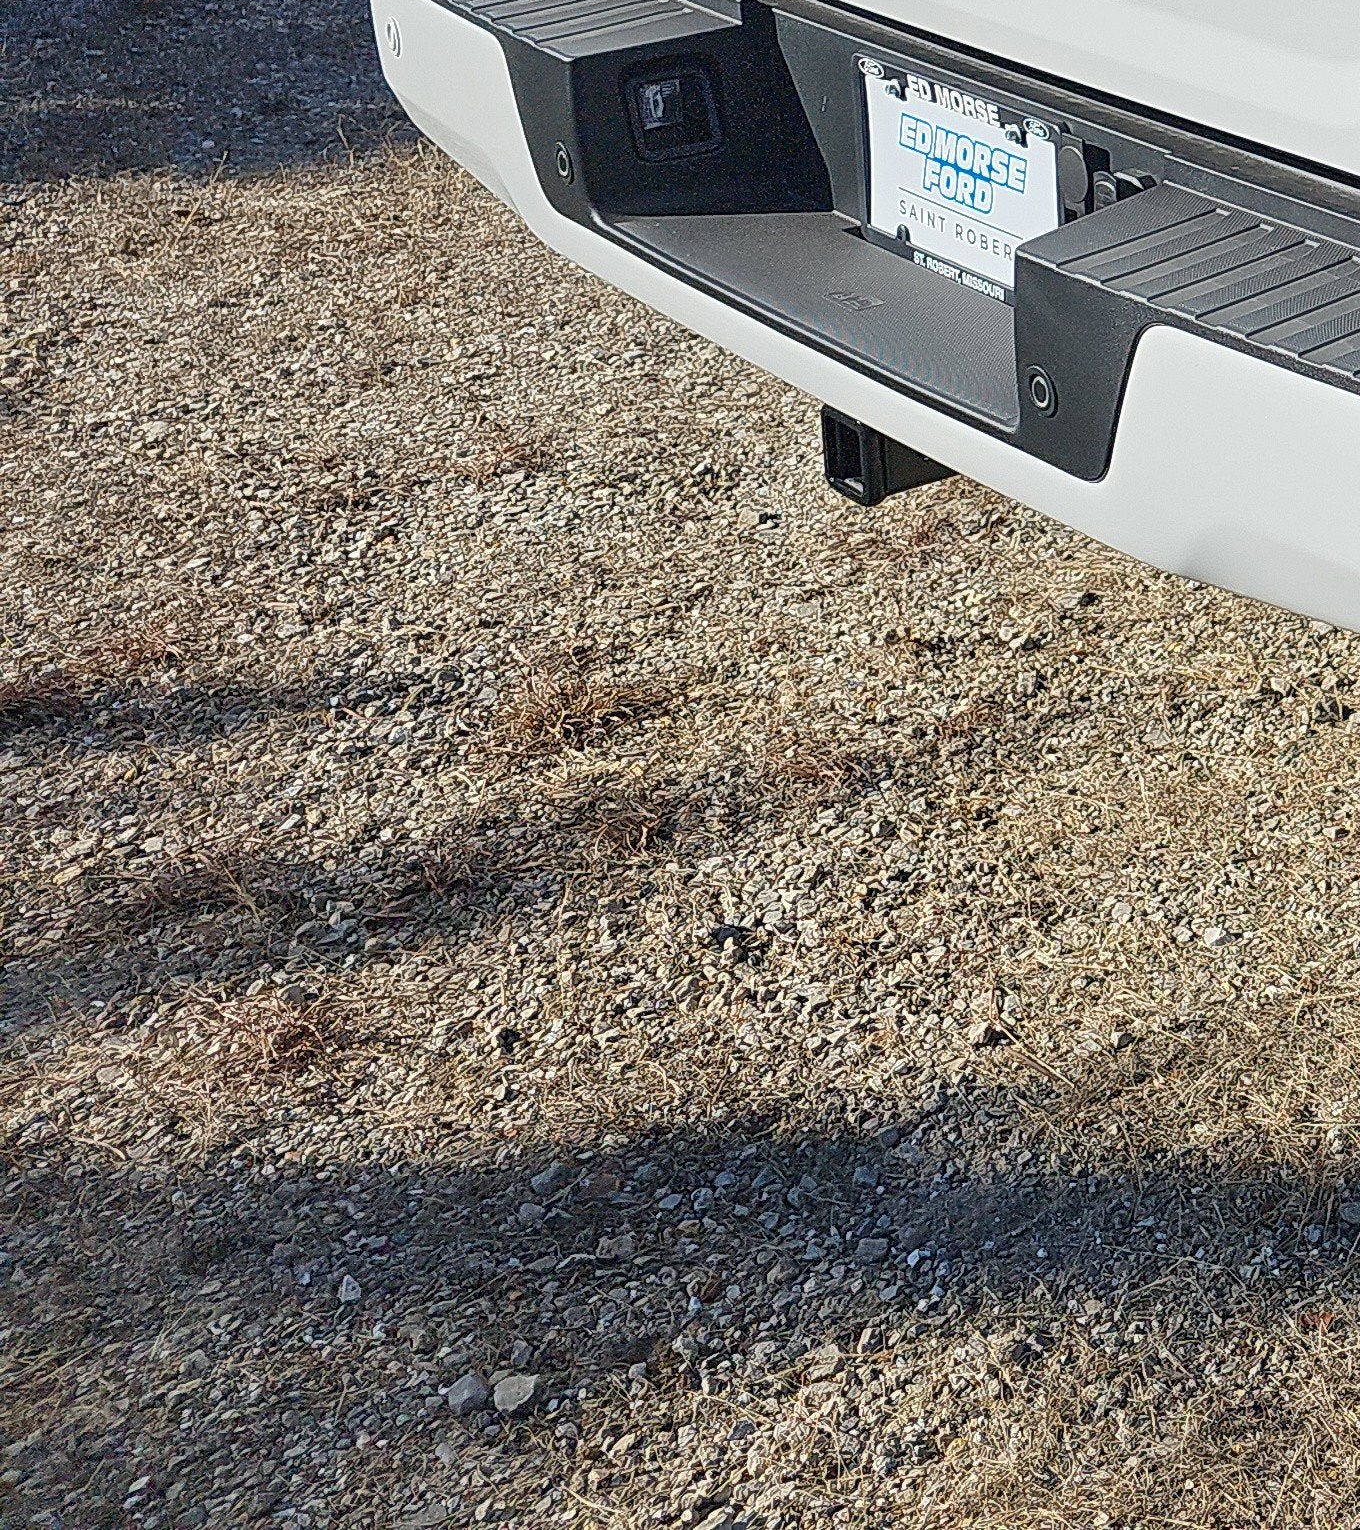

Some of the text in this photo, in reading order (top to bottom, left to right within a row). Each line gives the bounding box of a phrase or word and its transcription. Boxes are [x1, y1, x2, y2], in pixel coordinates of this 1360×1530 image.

[906, 74, 1001, 127] ED MORSE
[899, 112, 1028, 194] ED MORSE
[923, 157, 993, 214] FORD
[899, 199, 1014, 261] SAINT ROBER
[961, 272, 1005, 302] MISSOURI
